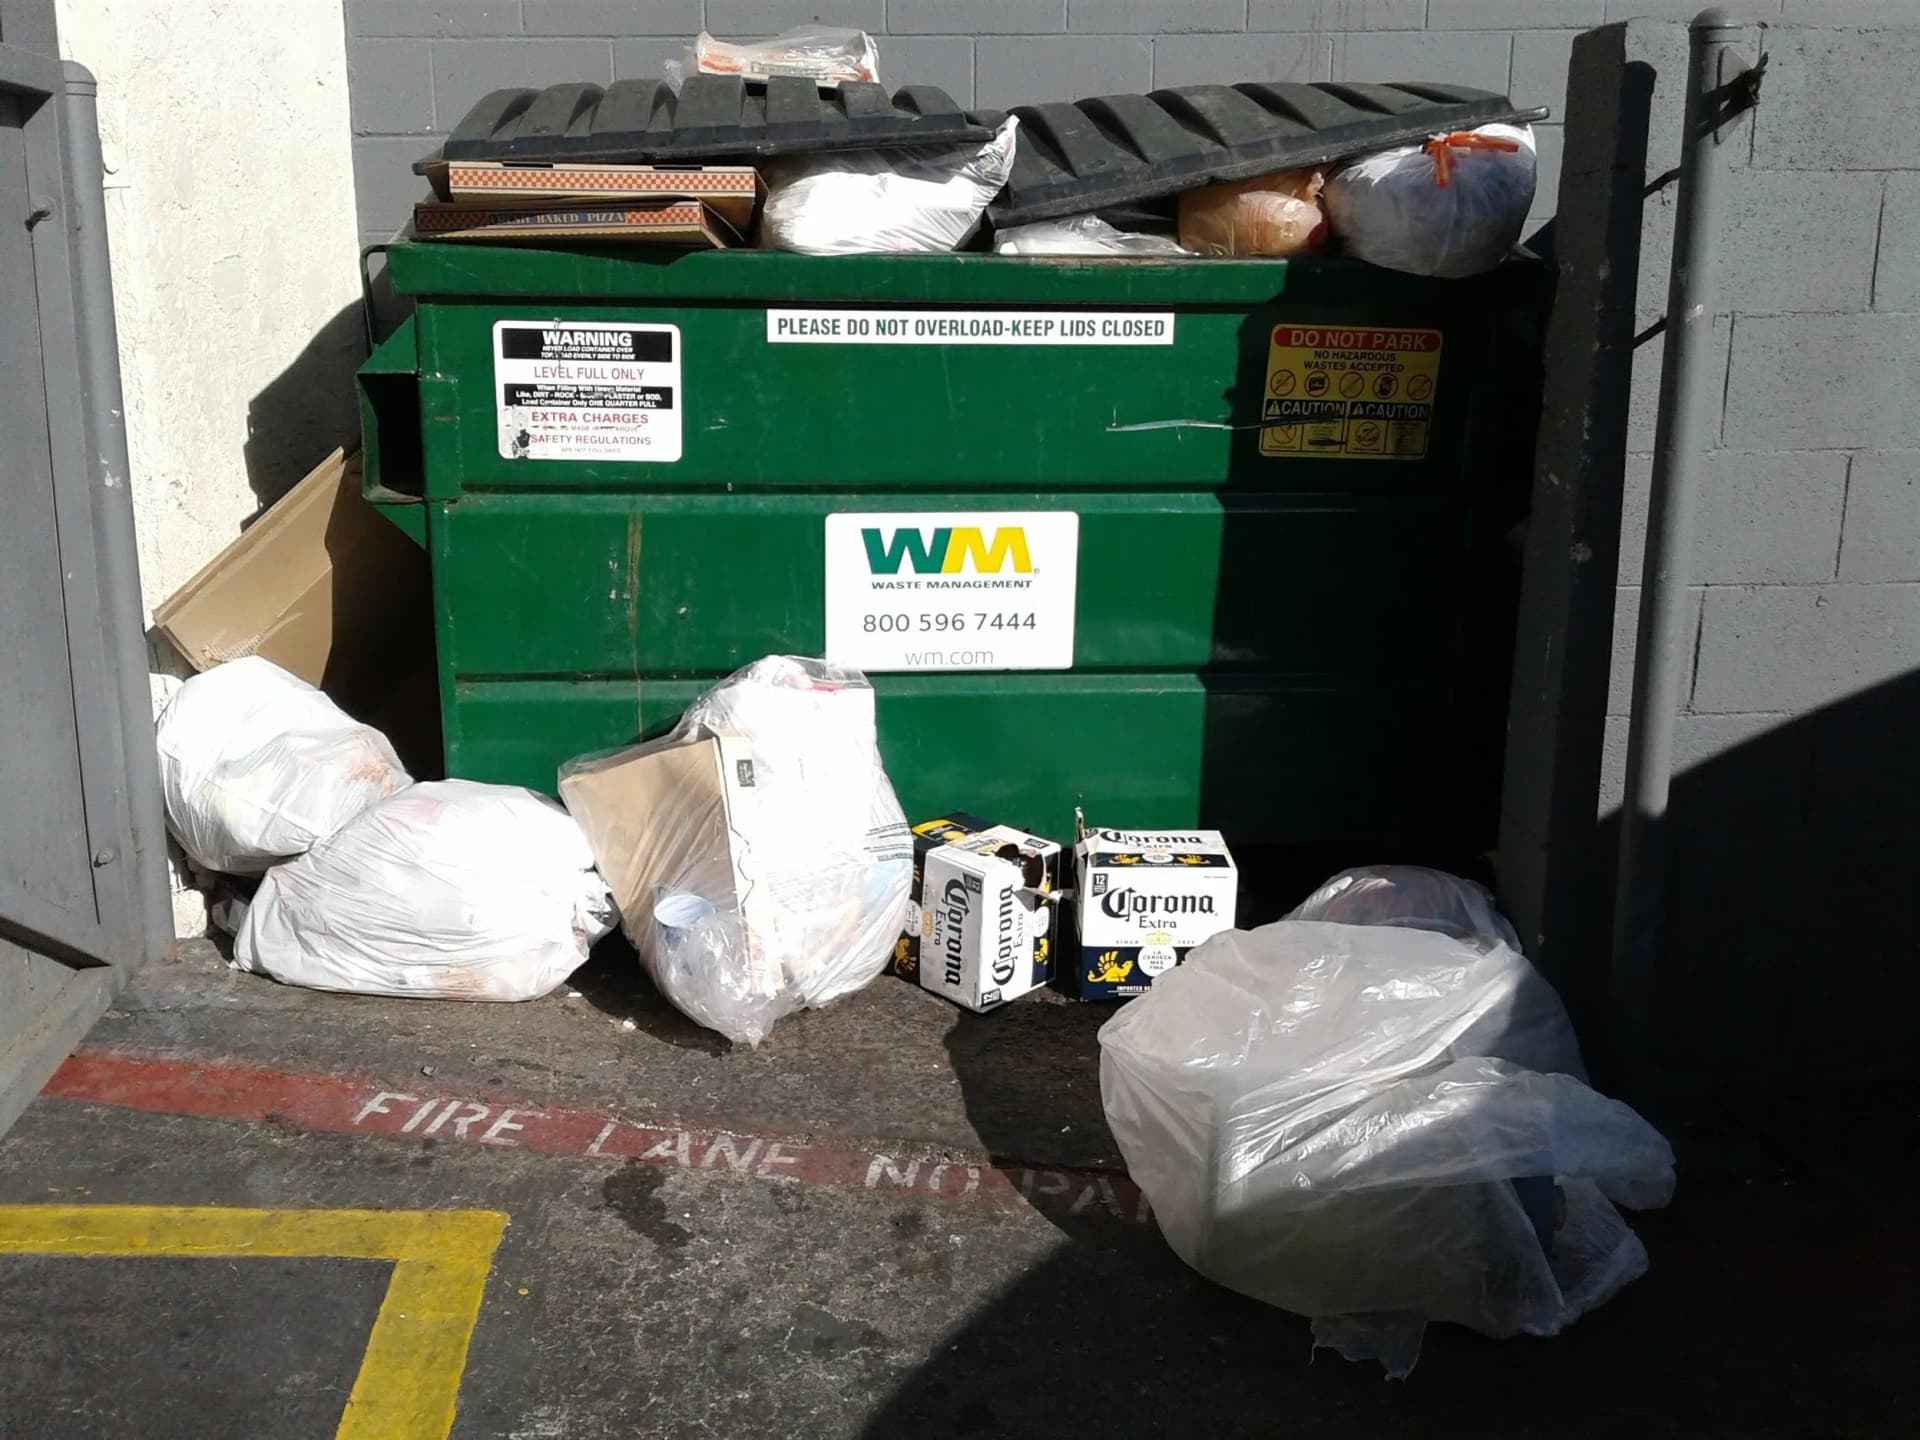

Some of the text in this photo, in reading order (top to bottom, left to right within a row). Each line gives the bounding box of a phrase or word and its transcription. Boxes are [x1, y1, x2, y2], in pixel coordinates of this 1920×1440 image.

[536, 213, 580, 224] BAKED
[587, 212, 624, 222] PIZZA
[778, 318, 1165, 336] PLEASE DO NOT OVERLOAD-KEEP LIDS CLOSED
[542, 330, 633, 347] WARNING
[1290, 330, 1427, 350] DO NOT PARK
[1314, 350, 1396, 362] NO HAZARDOUS
[534, 366, 644, 381] LEVEL FULL ONLY
[1304, 361, 1404, 372] WASTES ACCEPTED
[557, 384, 577, 392] Filling
[1281, 401, 1345, 416] CAUTION
[1366, 404, 1429, 419] CAUTION
[532, 412, 649, 424] EXTRA CHARGES
[531, 435, 651, 445] SAFETY REGULATIONS
[861, 526, 1032, 574] WM
[871, 580, 1032, 590] WASTE MANAGEMENT
[863, 612, 1036, 632] 800 596 7444
[905, 650, 994, 665] wm.com
[1100, 830, 1203, 845] Corona
[1096, 875, 1105, 885] 12
[1101, 887, 1216, 922] Corona
[934, 910, 946, 946] Extra
[1138, 916, 1177, 928] Extra
[942, 878, 970, 986] Corona
[992, 884, 1018, 985] Corona
[1014, 913, 1023, 947] Extra
[352, 1092, 546, 1147] FIRE
[584, 1121, 812, 1183] LANE
[866, 1154, 980, 1192] NO
